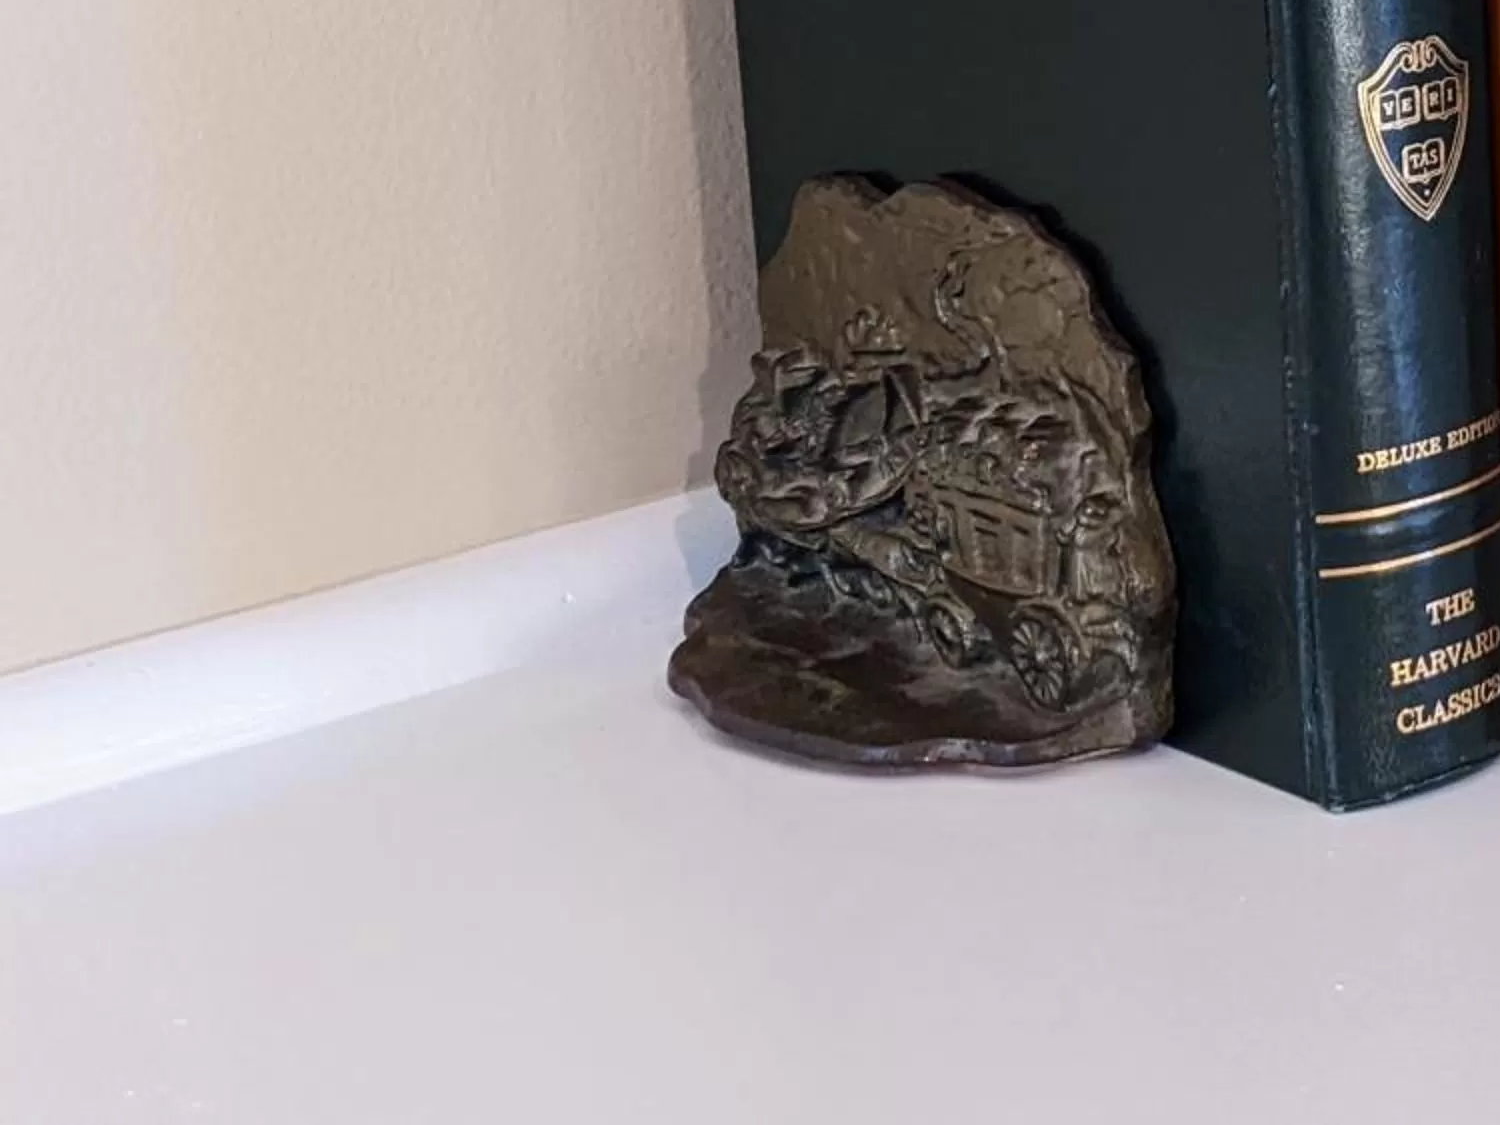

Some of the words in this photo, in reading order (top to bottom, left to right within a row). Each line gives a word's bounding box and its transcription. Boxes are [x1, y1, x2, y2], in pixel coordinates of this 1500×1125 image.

[1357, 436, 1443, 475] DELUXE
[1425, 588, 1476, 626] THE
[1390, 625, 1500, 687] HARVARD
